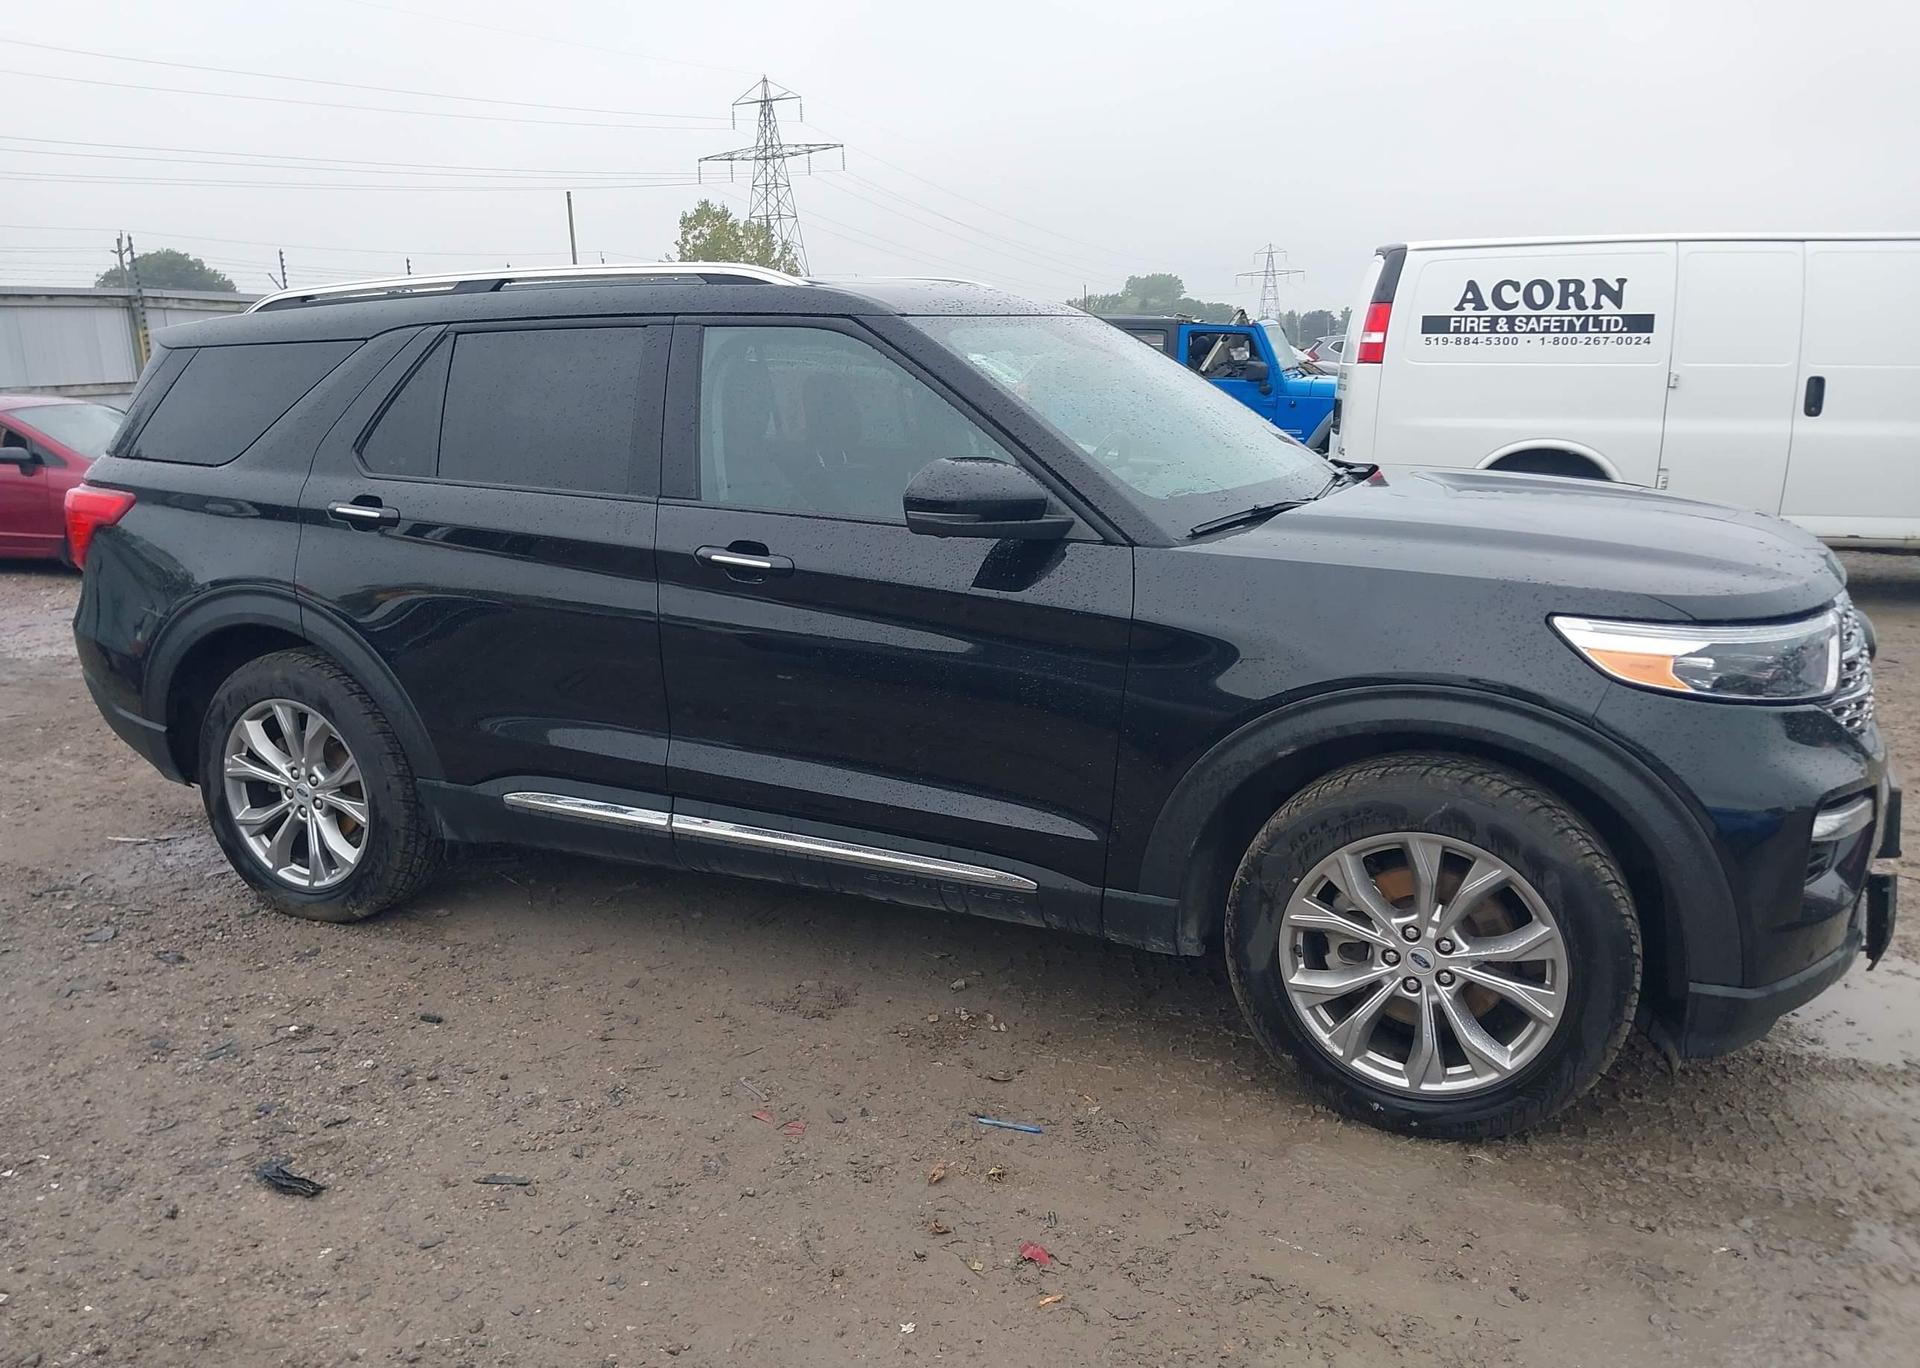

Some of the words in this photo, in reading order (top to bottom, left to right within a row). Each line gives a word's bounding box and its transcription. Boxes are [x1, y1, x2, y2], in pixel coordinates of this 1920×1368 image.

[1454, 278, 1628, 311] ACORN
[1449, 317, 1491, 333] FIRE
[1496, 317, 1509, 333] &
[1514, 316, 1587, 333] SAFETY
[1588, 316, 1628, 332] LTD.
[1424, 336, 1519, 346] 519-884-5300
[1539, 336, 1651, 346] 1-800-267-0024
